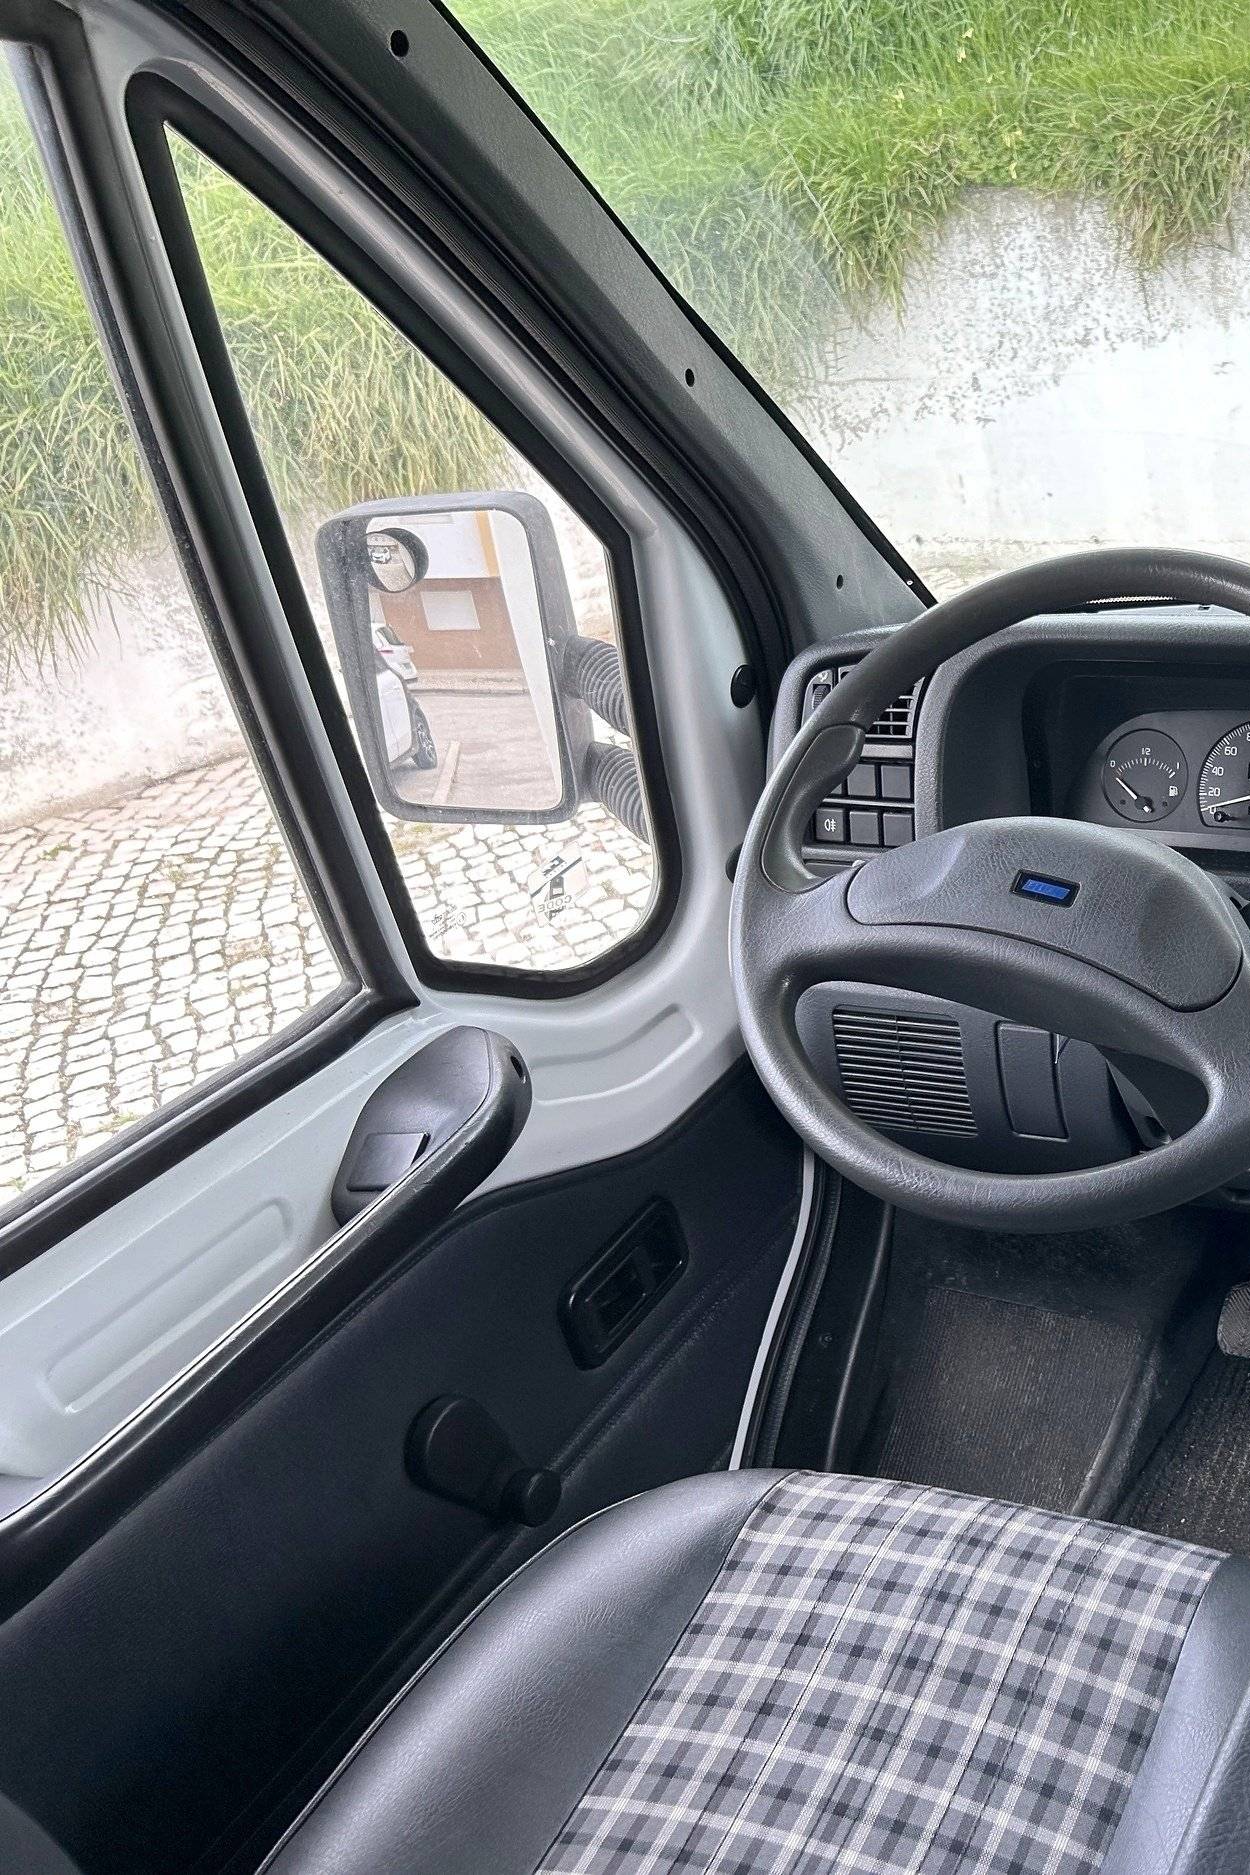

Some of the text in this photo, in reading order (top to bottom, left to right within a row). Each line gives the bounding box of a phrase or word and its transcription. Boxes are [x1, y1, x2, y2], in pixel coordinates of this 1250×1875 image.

[1224, 746, 1237, 756] 60
[1211, 766, 1224, 776] 40
[1208, 787, 1220, 796] 20
